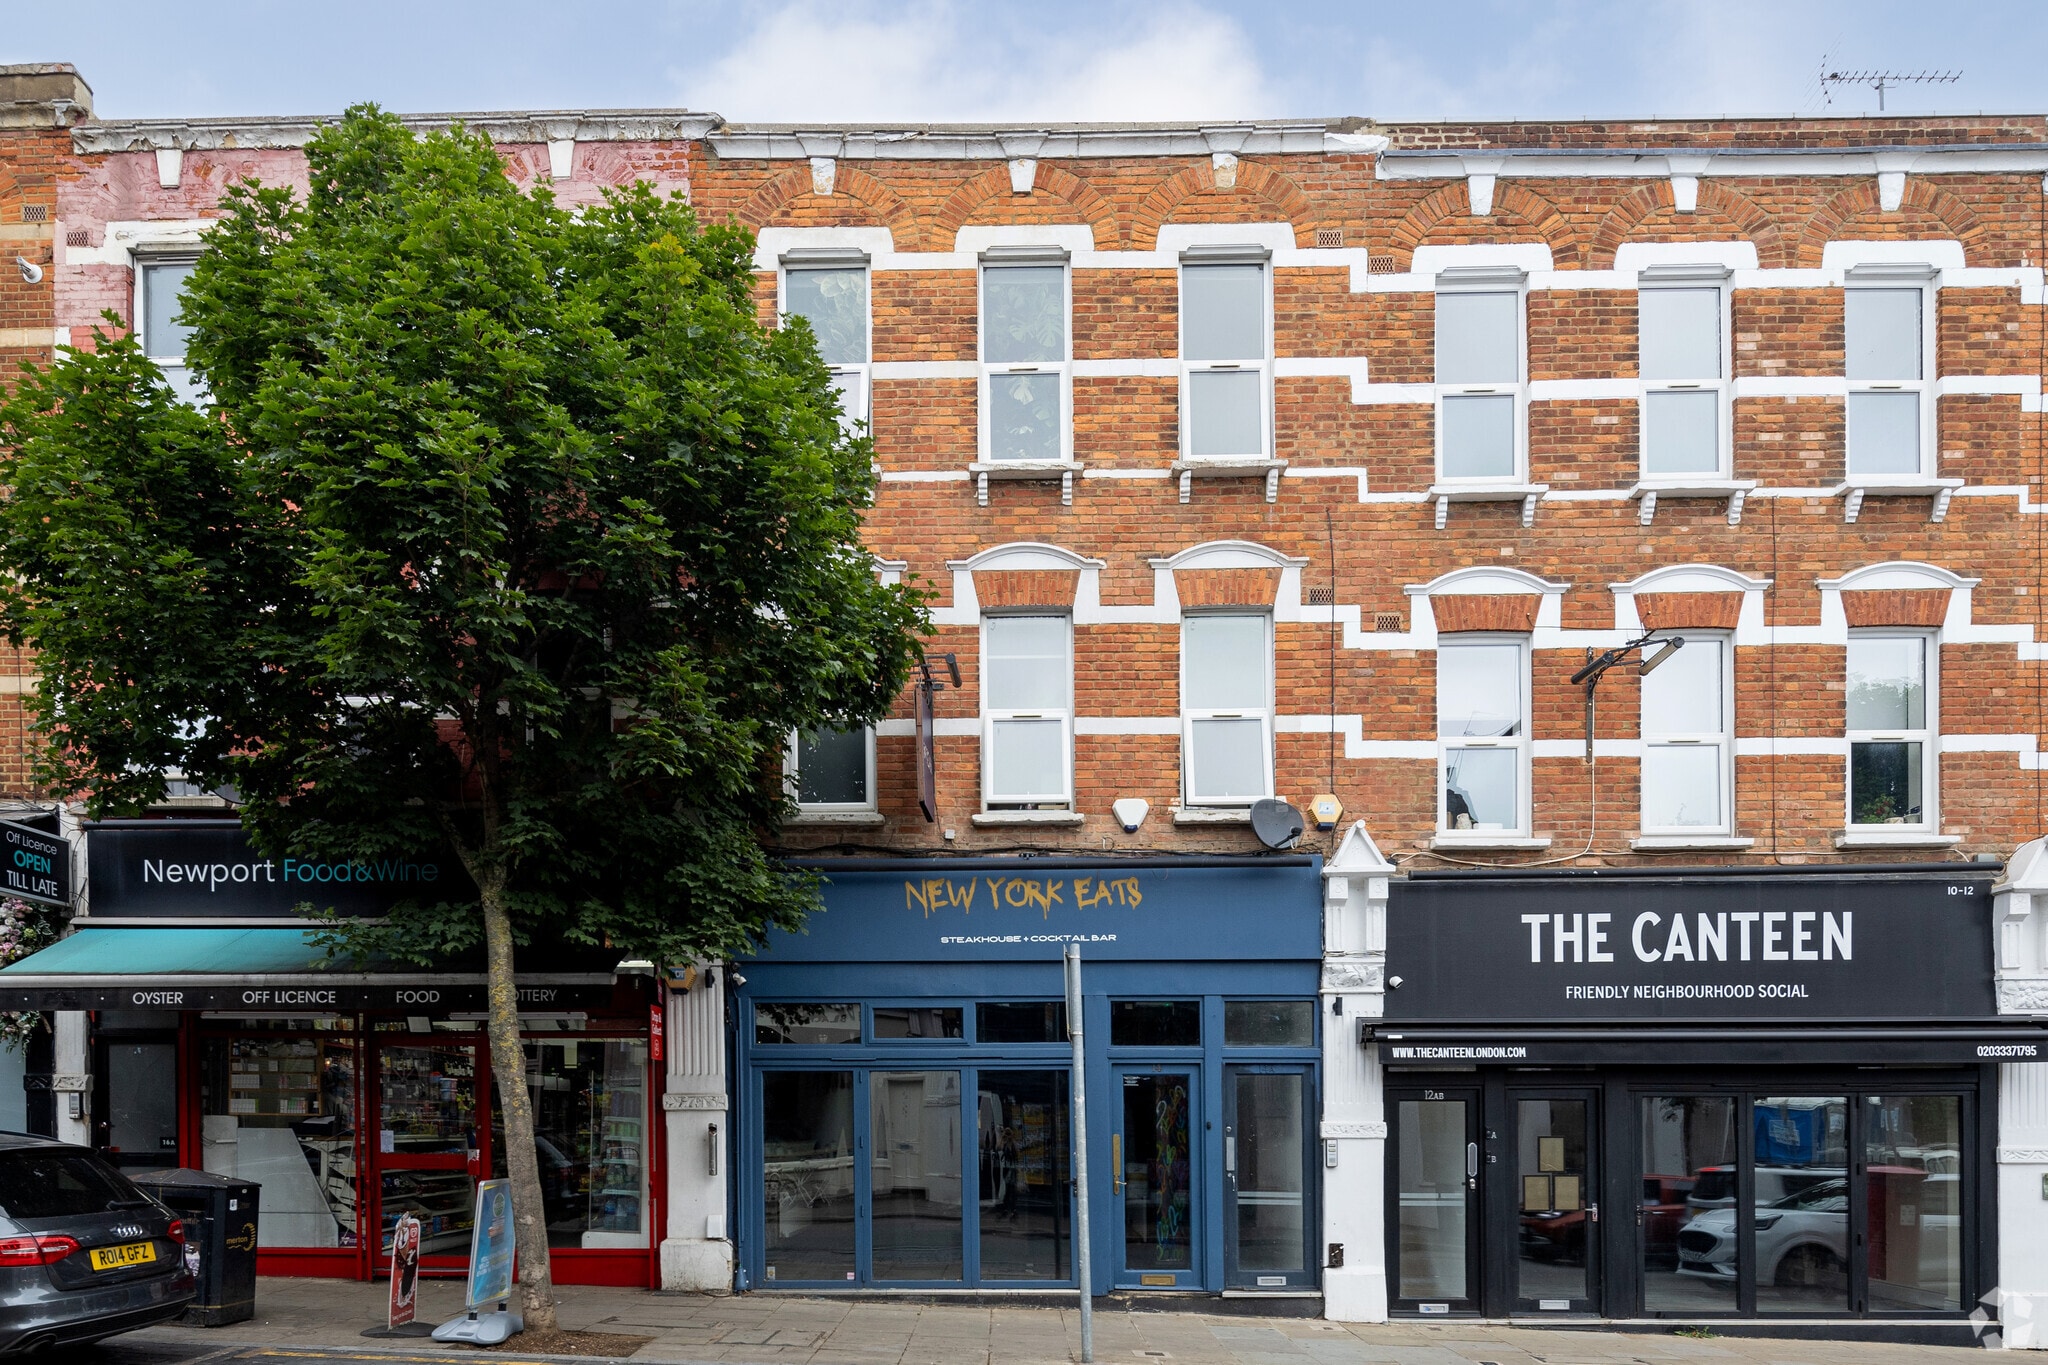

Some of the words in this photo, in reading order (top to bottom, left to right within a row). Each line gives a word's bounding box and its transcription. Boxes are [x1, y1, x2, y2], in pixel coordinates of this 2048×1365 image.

[6, 830, 20, 844] Off
[22, 835, 57, 855] Licence
[13, 849, 51, 874] OPEN
[143, 858, 275, 892] Newport
[283, 858, 438, 882] Food&Wine
[6, 869, 29, 890] TILL
[32, 876, 58, 897] LATE
[1947, 886, 1974, 896] 10-12
[905, 876, 977, 919] NEW
[986, 876, 1064, 920] YORK
[1074, 876, 1143, 911] EATS
[940, 936, 1022, 944] STEAKHOUSE
[1030, 934, 1090, 942] COCKTAIL
[1091, 934, 1117, 942] BAR
[1521, 912, 1614, 963] THE
[1631, 911, 1853, 963] CANTEEN
[132, 991, 184, 1004] OYSTER
[242, 991, 270, 1004] OFF
[274, 991, 336, 1004] LICENCE
[396, 990, 440, 1003] FOOD
[1565, 985, 1630, 999] FRIENDLY
[1633, 984, 1755, 999] NEIGHBOURHOOD
[1758, 984, 1809, 998] SOCIAL
[1392, 1046, 1527, 1058] WWW.THECANTEENLONDON.COM
[1976, 1045, 2038, 1057] 02033371795
[1424, 1090, 1445, 1100] 12AB
[225, 1236, 249, 1245] merton
[98, 1248, 126, 1266] RO14
[126, 1243, 149, 1261] GFZ
